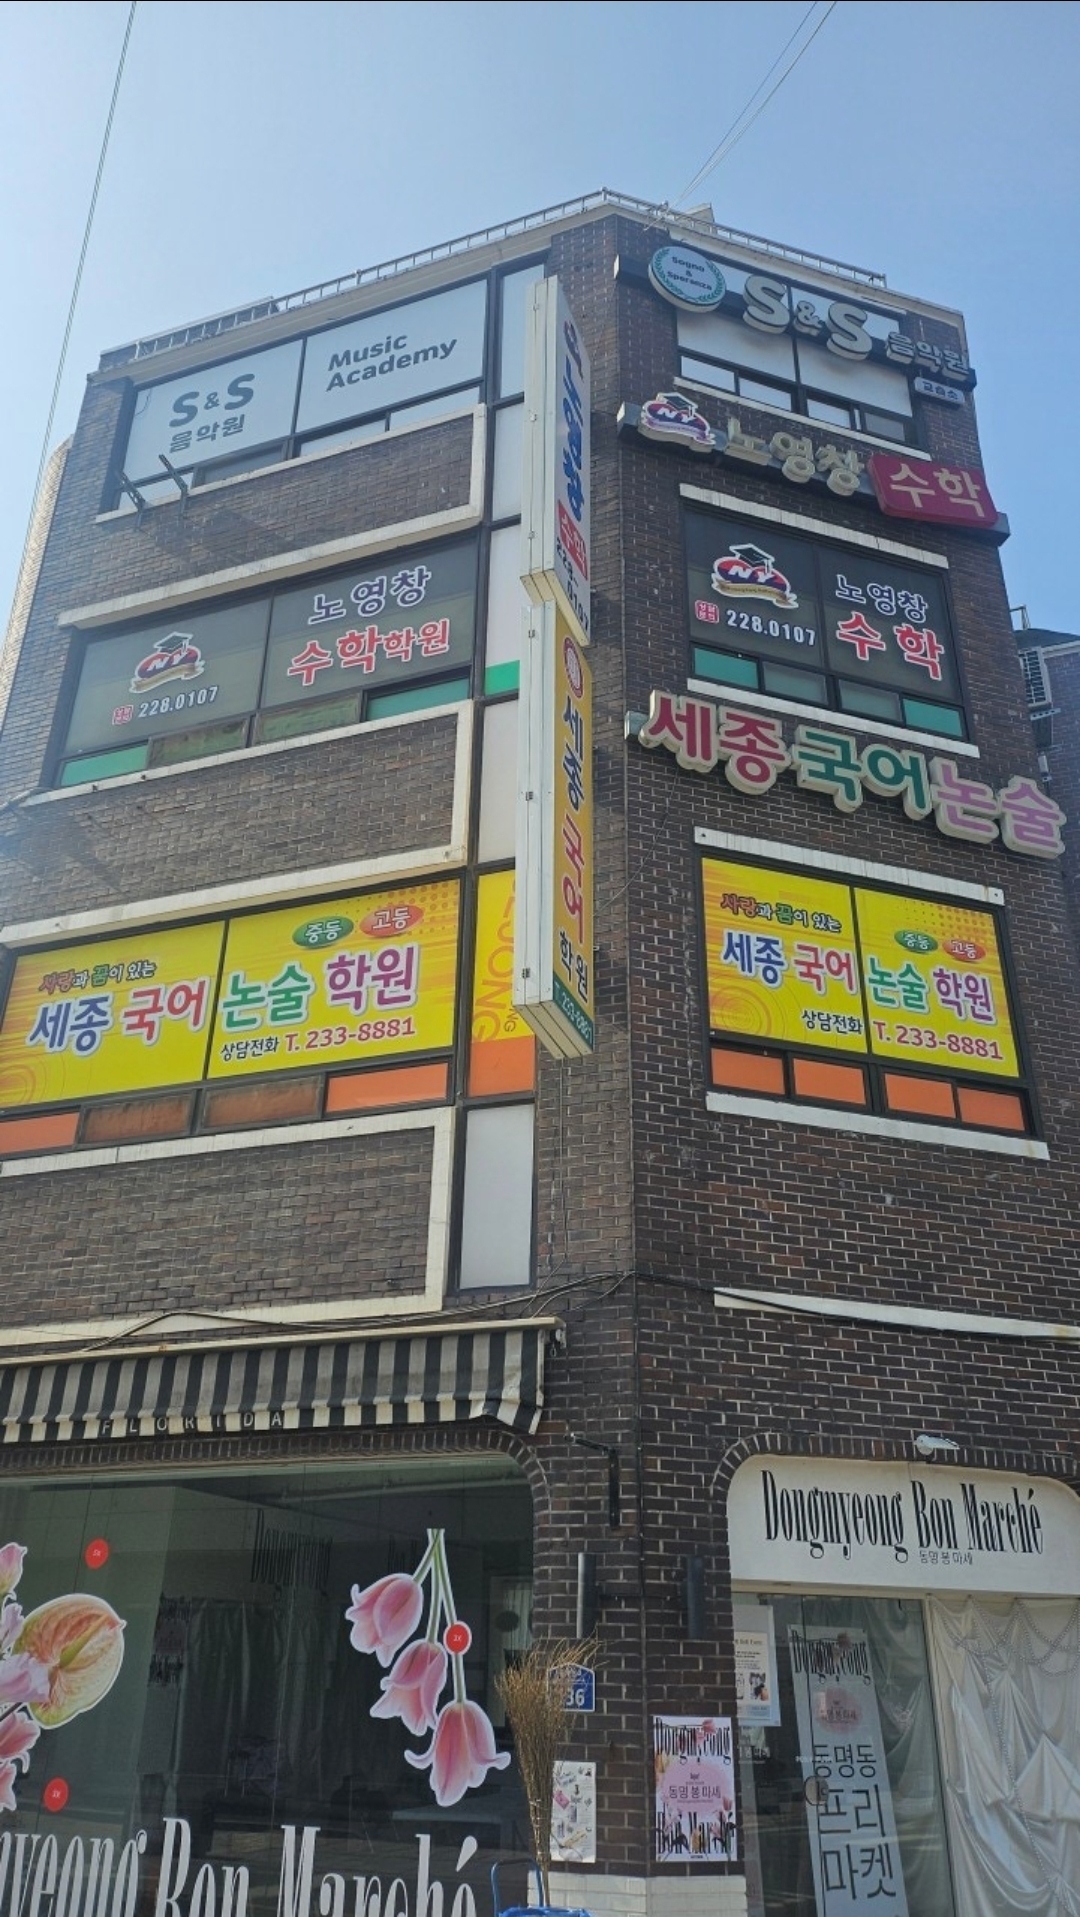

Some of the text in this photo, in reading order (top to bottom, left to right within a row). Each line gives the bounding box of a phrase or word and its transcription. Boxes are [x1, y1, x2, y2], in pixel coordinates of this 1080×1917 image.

[326, 339, 458, 392] Academy
[327, 334, 407, 371] Music
[887, 332, 970, 377] 음악원
[169, 413, 246, 454] 음악원
[724, 417, 865, 495] 노영창
[889, 463, 985, 518] 수학
[308, 566, 431, 624] 노영창
[836, 574, 928, 623] 노영창
[726, 610, 815, 645] 228.0107
[836, 611, 945, 681] 수학
[138, 686, 218, 718] 228.0107
[306, 920, 341, 943] 중등
[372, 906, 409, 932] 고등
[721, 893, 773, 920] 사랑과
[812, 910, 843, 933] 있는
[903, 930, 931, 951] 중등
[951, 941, 978, 960] 고등
[39, 968, 89, 995] 사랑과
[126, 959, 157, 981] 있는
[722, 930, 995, 1023] 세종 국어 논술 학원
[27, 944, 420, 1057] 세종 국어 논술 학원
[220, 1036, 280, 1062] 상담전화
[305, 1017, 415, 1050] 233-8881
[802, 1009, 863, 1034] 상담전화
[896, 1025, 1003, 1060] 233-8881
[761, 1470, 1043, 1563] Dongmyeong Bon Marché
[813, 1744, 876, 1778] 동명동
[823, 1843, 896, 1900] 마켓
